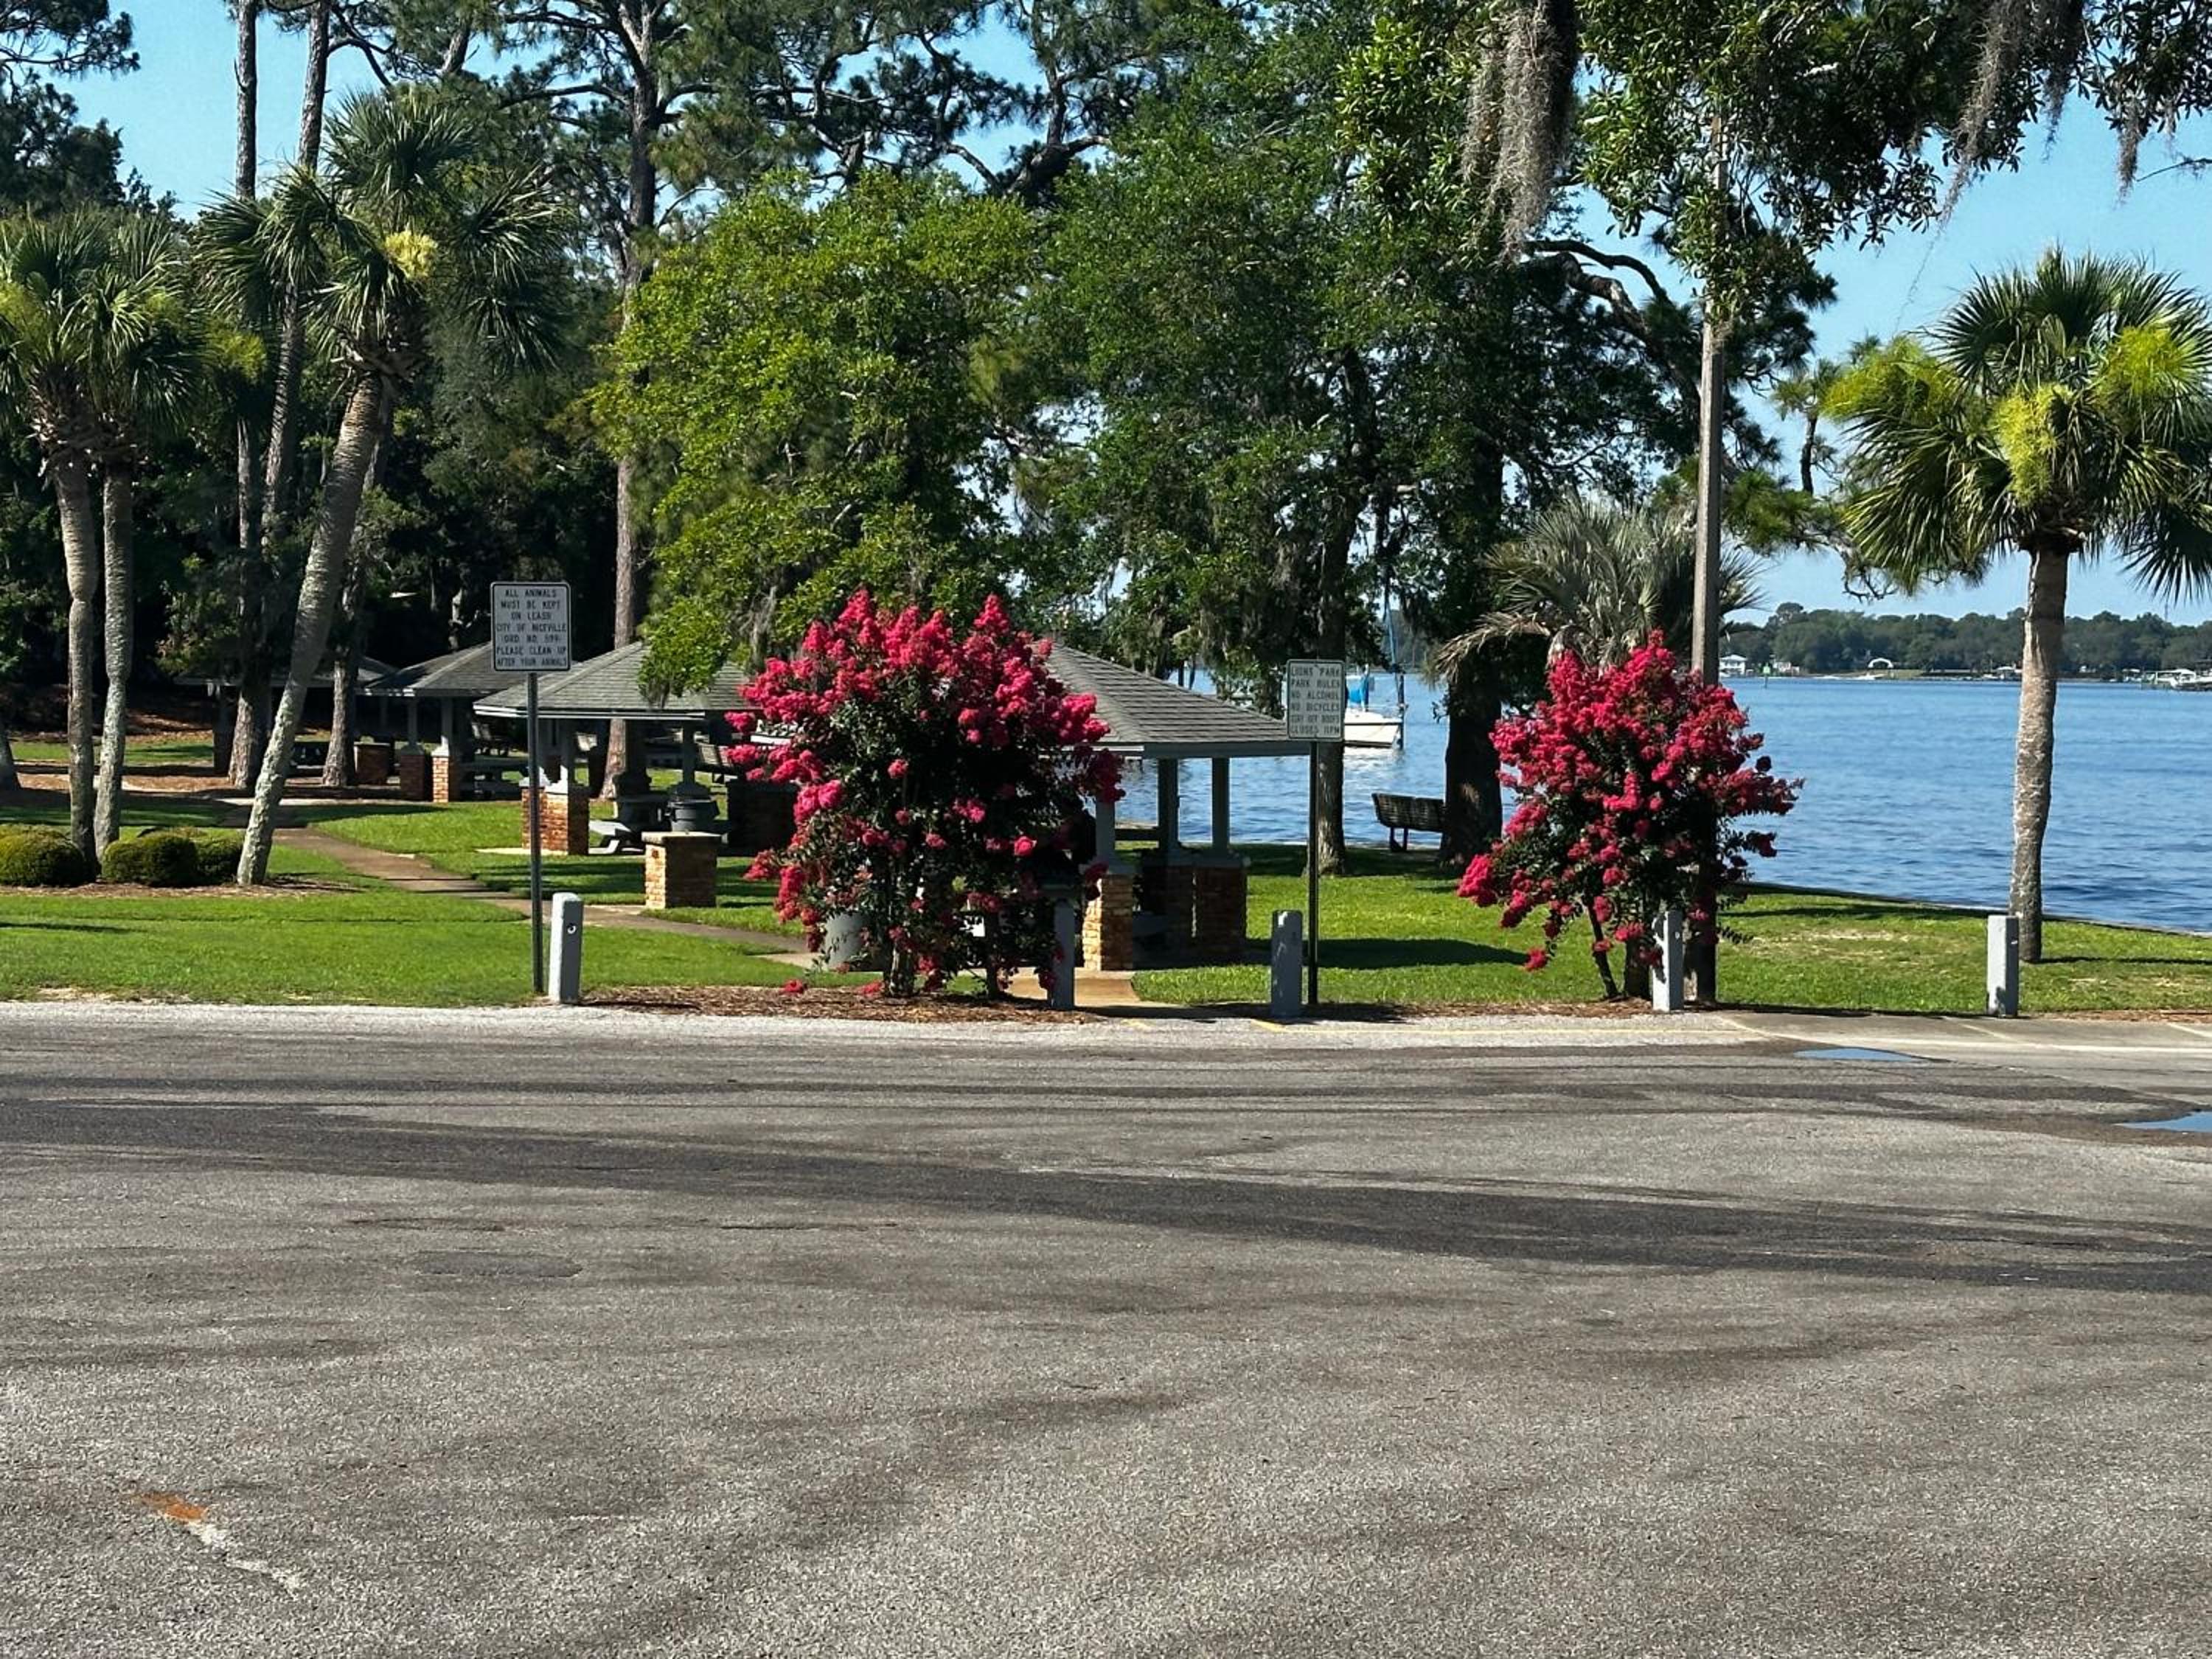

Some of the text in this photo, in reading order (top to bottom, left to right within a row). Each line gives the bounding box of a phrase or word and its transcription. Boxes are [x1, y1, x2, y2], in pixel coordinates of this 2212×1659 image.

[505, 589, 556, 597] ALL ANIMALS
[501, 600, 560, 610] MUST BE KEPT
[511, 612, 552, 620] ON LEASH
[496, 623, 567, 632] CITY OF NICEVILLE
[496, 645, 567, 655] PLEASE CLEAN UP
[1319, 667, 1340, 677] PARK
[1291, 679, 1340, 689] PARK RULES
[1307, 690, 1338, 700] ALCOHOL
